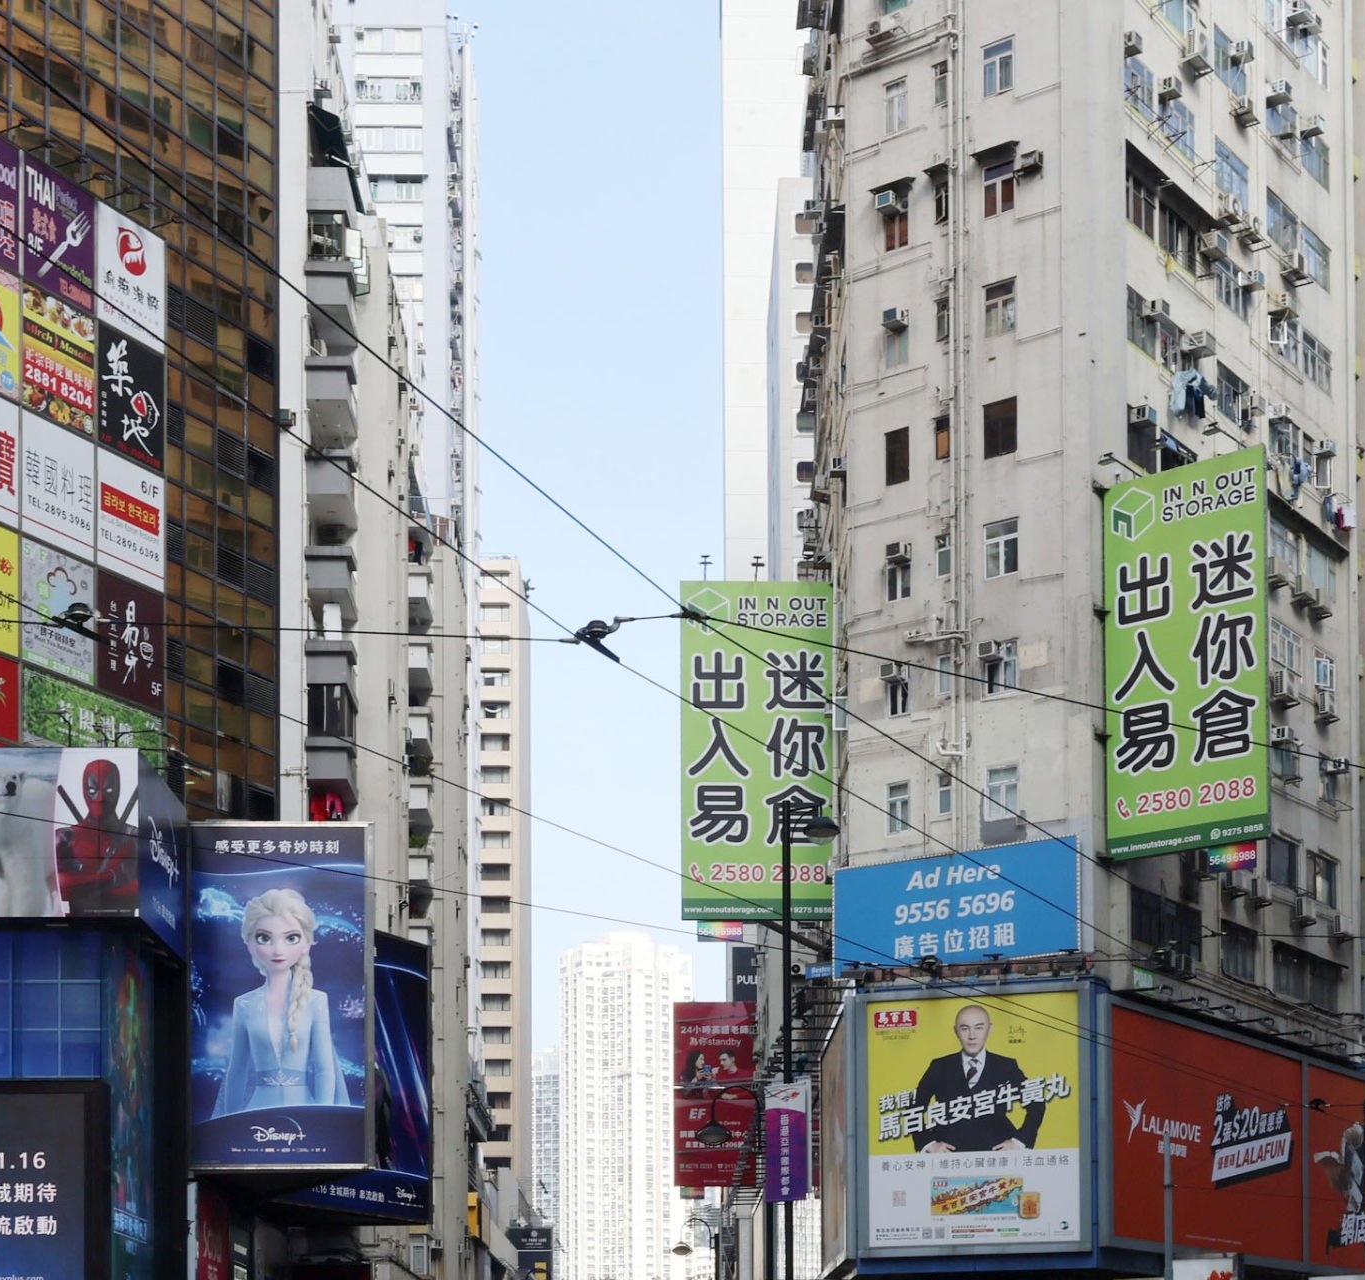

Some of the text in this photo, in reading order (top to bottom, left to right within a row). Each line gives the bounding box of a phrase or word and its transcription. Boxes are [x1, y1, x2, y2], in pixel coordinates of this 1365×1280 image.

[25, 164, 56, 212] THAI
[26, 321, 53, 344] Mirch
[25, 363, 93, 410] 2881 8204
[26, 446, 93, 513] 韓國料理
[140, 480, 159, 499] 6/F
[1163, 466, 1256, 505] IN N OUT
[27, 494, 91, 532] TEL:2895 3986
[1162, 485, 1256, 524] STORAGE
[100, 527, 160, 563] TEL:2895 6398
[738, 597, 827, 612] IN N OUT
[736, 612, 827, 628] STORAGE
[1191, 533, 1257, 764] 迷你倉
[1113, 555, 1176, 774] 出入易
[150, 681, 163, 697] 5F
[688, 650, 750, 844] 出入易
[1136, 776, 1256, 814] 2580 2088
[1111, 833, 1202, 855] www.innoutstorage.com
[1222, 823, 1264, 838] 9275 8858
[214, 839, 340, 855] 感受更多奇妙時刻
[710, 863, 765, 882] 2580
[905, 863, 1002, 892] Ad Here
[684, 906, 774, 915] www.innoutstorage.com
[894, 889, 1016, 926] 9556 5696
[894, 921, 1016, 960] 廣告位招租
[688, 1036, 742, 1048] 為你standby
[688, 1107, 707, 1120] EF
[878, 1071, 1072, 1141] 馬百良安宮牛黃丸
[250, 1125, 307, 1146] Disney+
[1141, 1113, 1202, 1143] LALAMOVE
[1021, 1154, 1070, 1167] 活血通絡
[1235, 1138, 1286, 1169] LALAFUN
[329, 1185, 357, 1199] 全城期待
[358, 1189, 385, 1203] 串流啟動
[395, 1186, 417, 1203] Disney+
